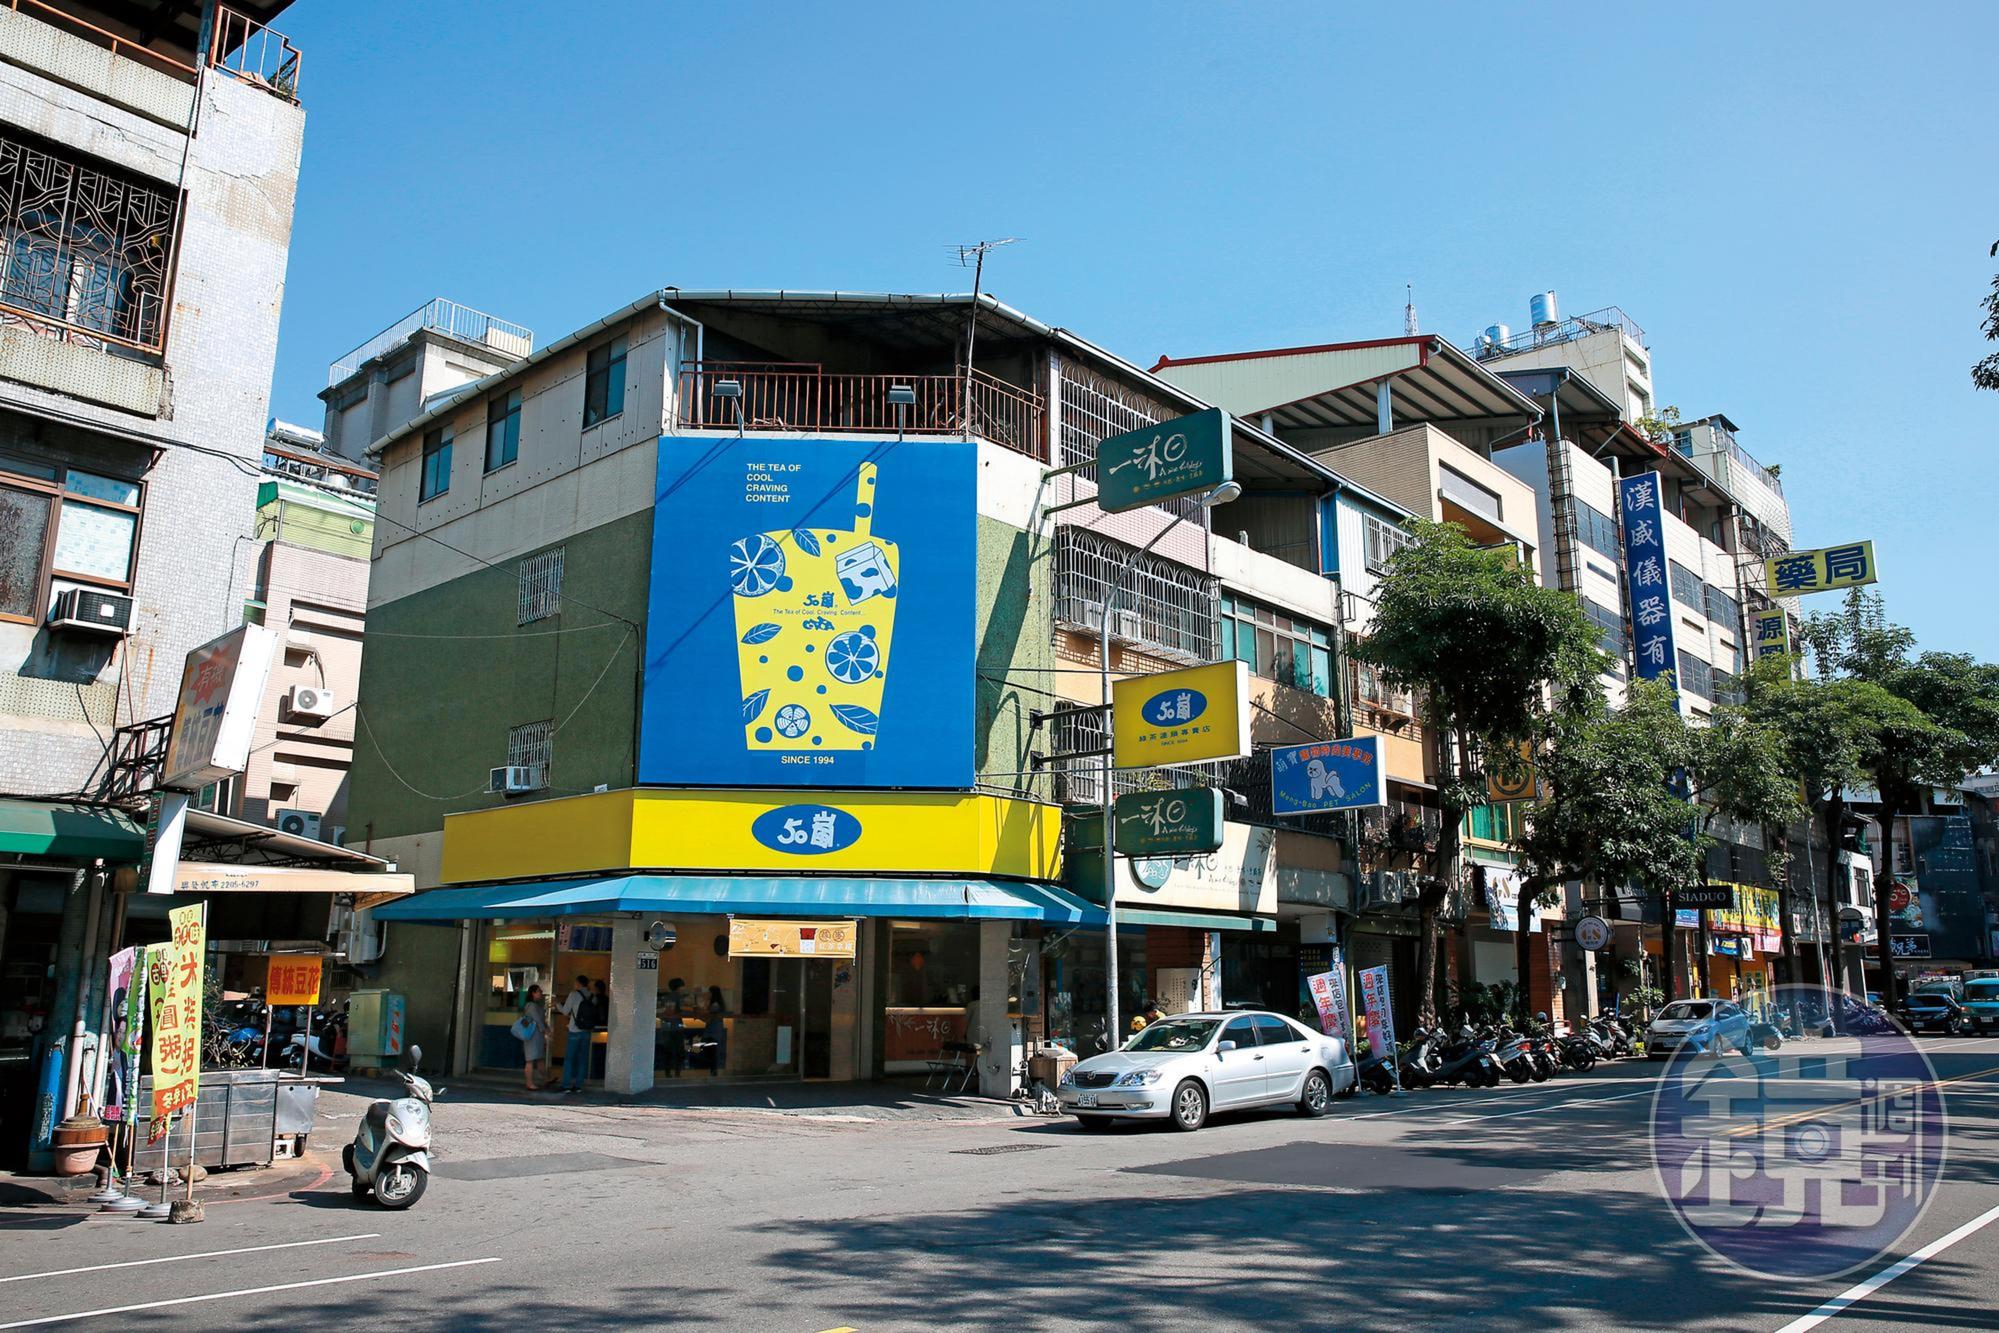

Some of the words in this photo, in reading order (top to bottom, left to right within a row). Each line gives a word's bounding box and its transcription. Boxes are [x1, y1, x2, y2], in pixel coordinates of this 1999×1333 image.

[746, 484, 788, 492] CRAVING
[1626, 480, 1668, 665] 漢威儀器有
[1774, 547, 1868, 592] 藥局
[1157, 693, 1191, 720] 50嵐
[781, 756, 810, 764] SINCE
[1323, 800, 1339, 808] PET
[1346, 781, 1372, 801] SALON
[777, 811, 837, 849] 50嵐
[1679, 891, 1727, 902] SIADUO
[270, 965, 320, 995] 傳統豆花
[1312, 977, 1338, 1030] 週年慶
